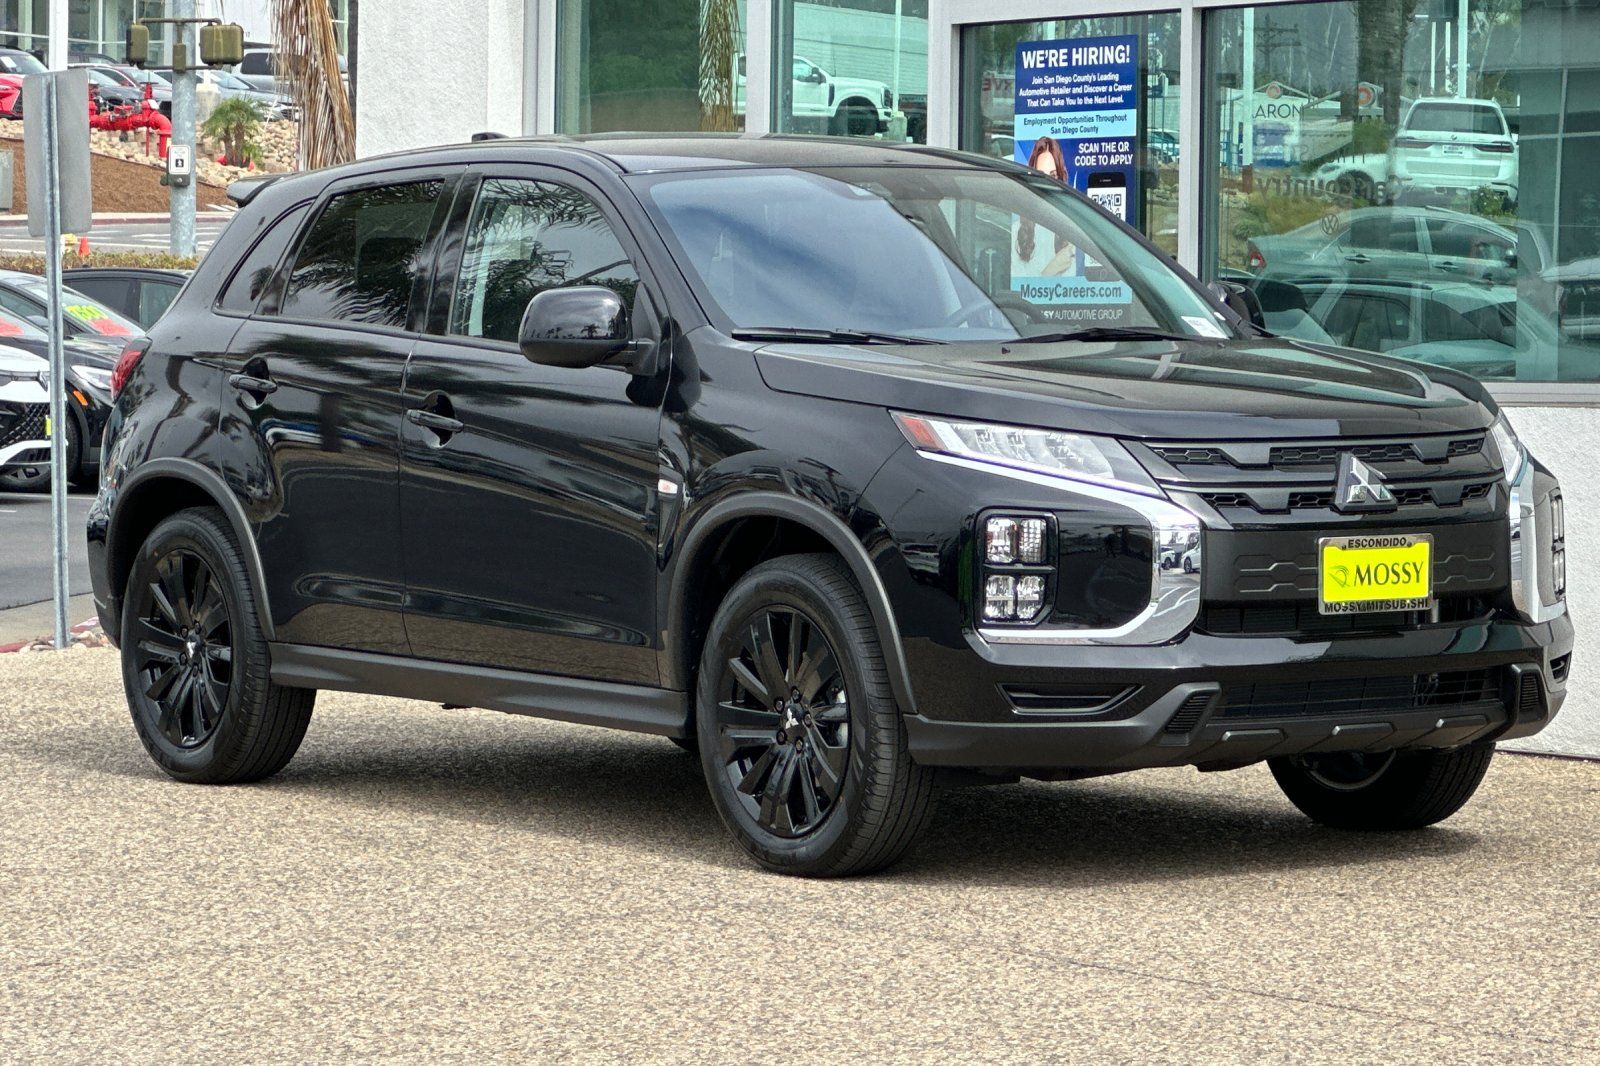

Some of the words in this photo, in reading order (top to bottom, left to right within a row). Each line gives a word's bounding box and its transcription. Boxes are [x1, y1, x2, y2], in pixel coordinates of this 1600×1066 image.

[1022, 48, 1068, 69] WE'RE
[1072, 44, 1131, 66] HIRING!
[1032, 76, 1043, 85] Join
[1044, 75, 1055, 83] San
[1056, 74, 1072, 84] Diego
[1073, 73, 1096, 83] County's
[1097, 72, 1119, 82] Leading
[1019, 87, 1050, 97] Automotive
[1050, 86, 1071, 95] Retailer
[1072, 86, 1083, 94] and
[1084, 84, 1108, 93] Discover
[1114, 83, 1132, 91] Career
[1027, 98, 1039, 107] That
[1039, 98, 1051, 107] Can
[1052, 97, 1065, 106] Take
[1066, 97, 1076, 106] You
[1077, 97, 1083, 105] to
[1084, 96, 1093, 104] the
[1094, 96, 1108, 104] Next
[1108, 95, 1123, 104] Level.
[1023, 117, 1057, 126] Employment
[1058, 115, 1094, 124] Opportunities
[1096, 114, 1127, 123] Throughout
[1051, 127, 1062, 135] San
[1063, 125, 1079, 135] Diego
[1080, 124, 1099, 134] County
[1078, 142, 1100, 153] SCAN
[1101, 141, 1116, 152] THE
[1118, 141, 1129, 152] QR
[1075, 154, 1097, 166] CODE
[1098, 155, 1108, 165] TO
[1110, 154, 1134, 164] APPLY
[1020, 282, 1122, 301] MossyCareers.com
[1055, 309, 1097, 320] AUTOMOTIVE
[1098, 309, 1123, 320] GROUP
[1348, 537, 1407, 549] ESCONDIDO
[1354, 561, 1424, 587] MOSSY
[1325, 601, 1364, 613] MOSSY
[1366, 599, 1428, 611] MITSUBISHI
